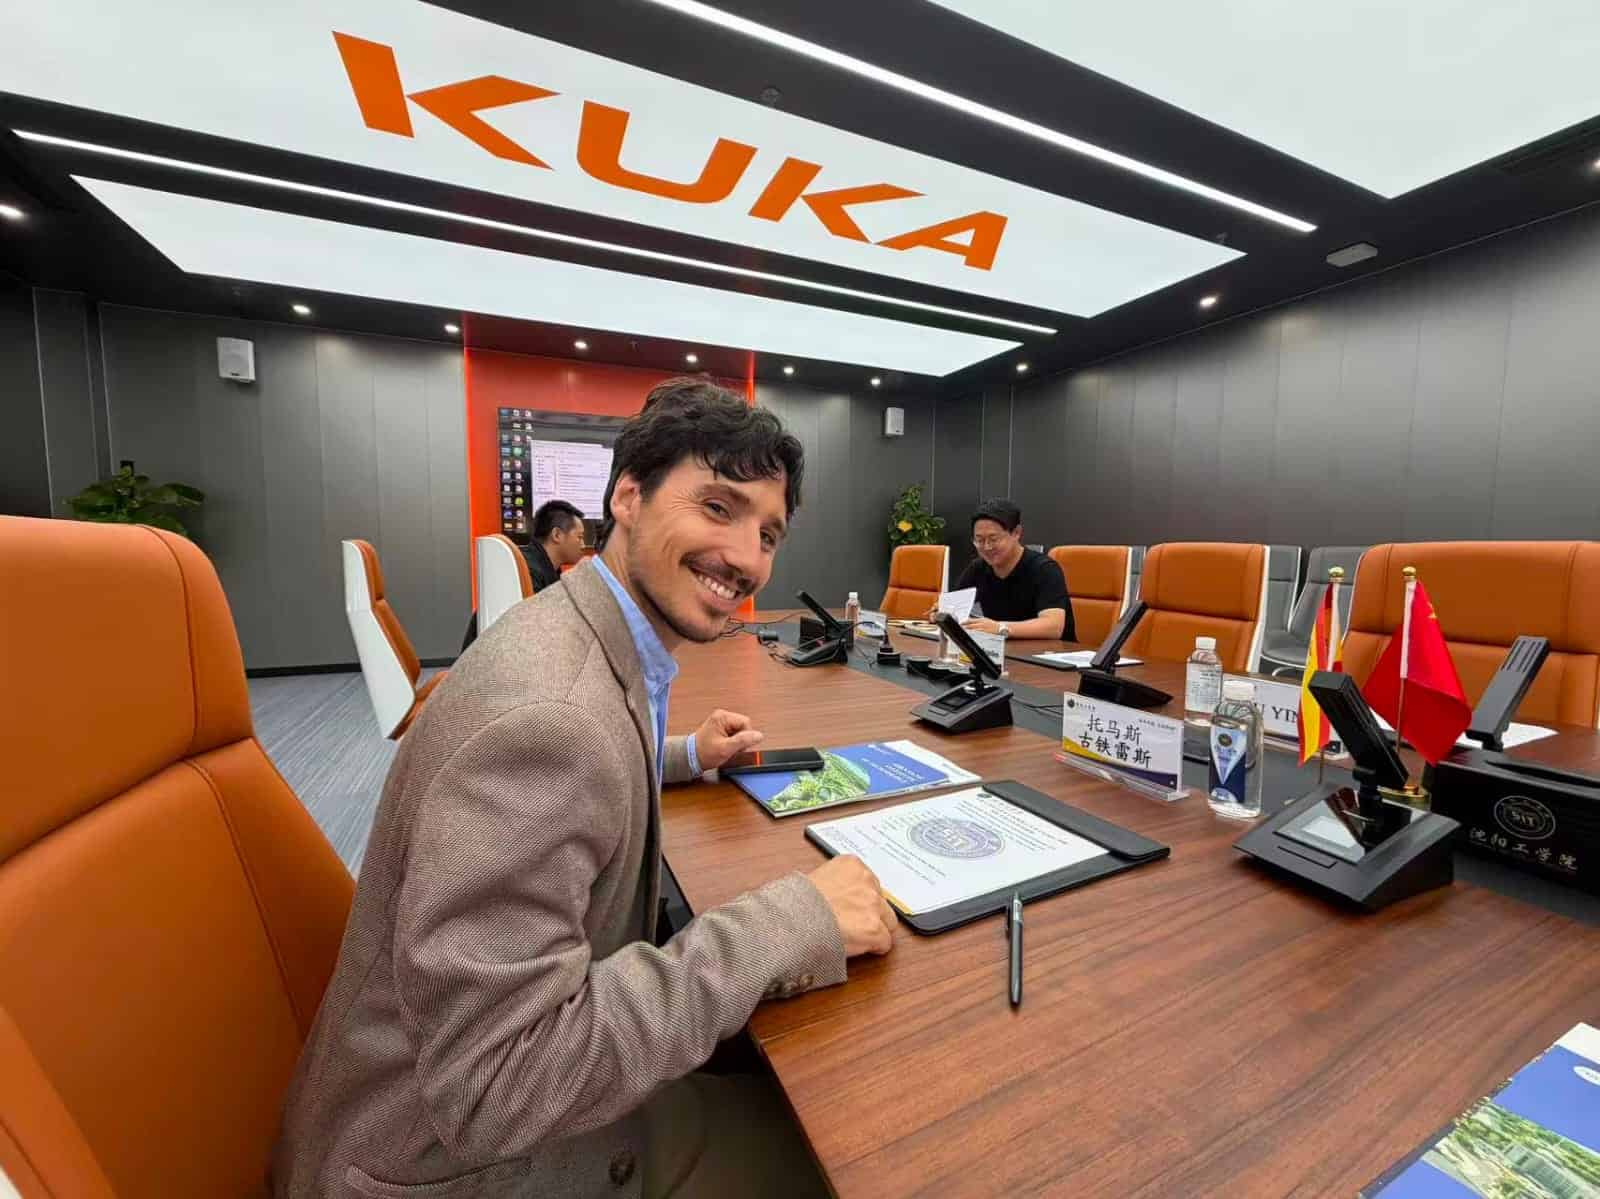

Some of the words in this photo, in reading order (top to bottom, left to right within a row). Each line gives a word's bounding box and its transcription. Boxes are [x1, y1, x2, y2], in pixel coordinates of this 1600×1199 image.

[332, 31, 1008, 271] KUKA
[1087, 714, 1142, 745] 托马斯
[1078, 731, 1152, 769] 古铁雷斯
